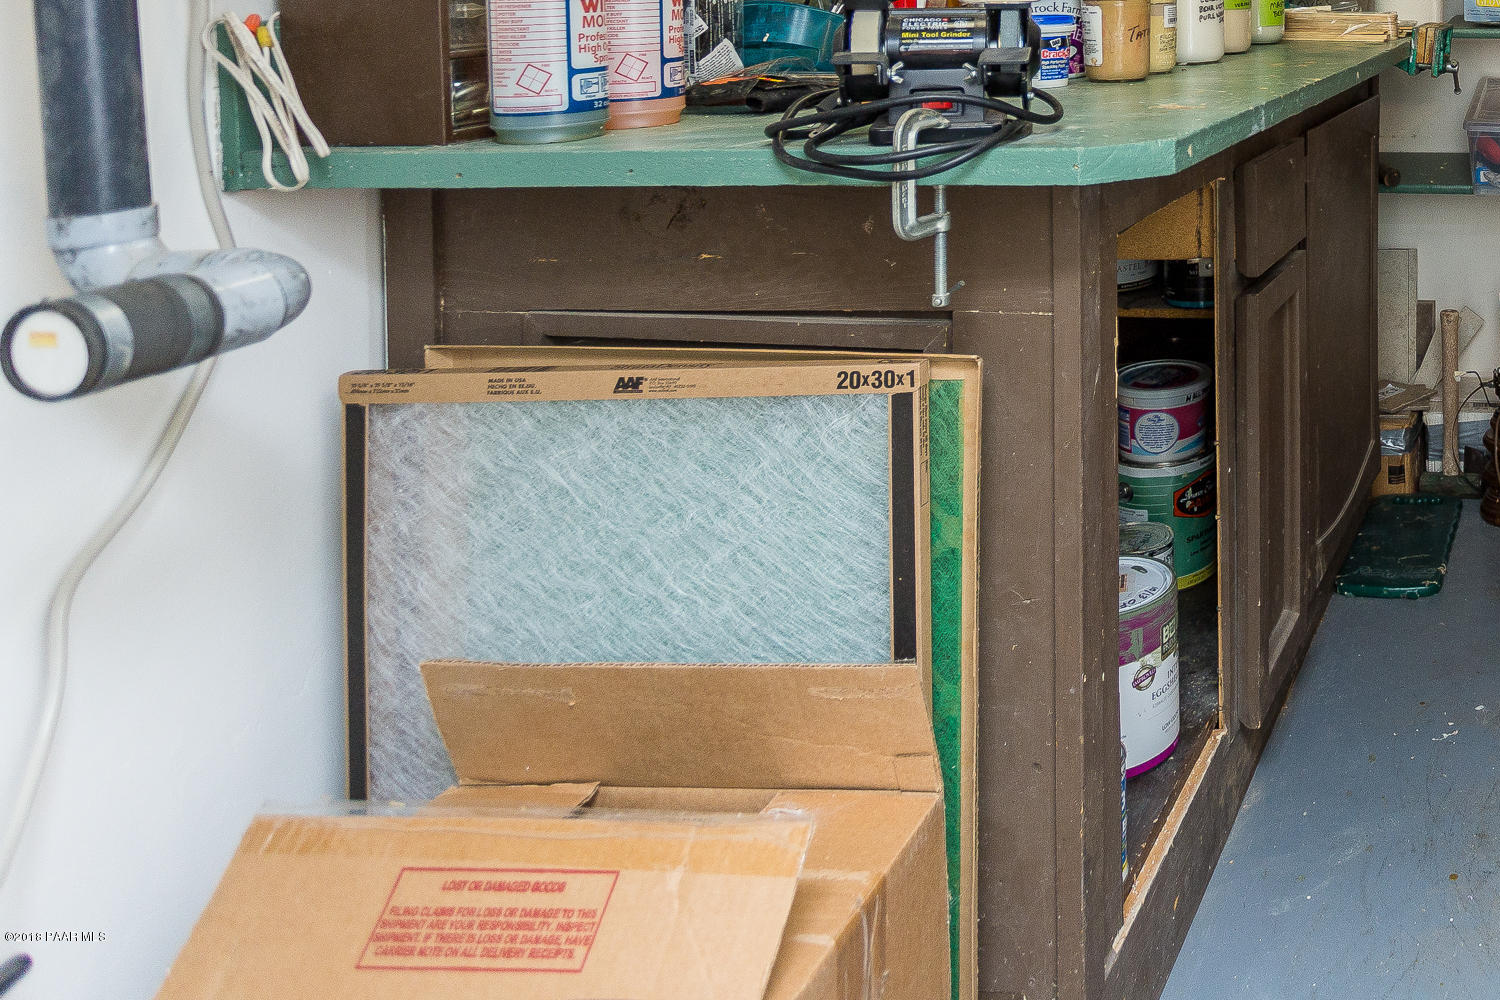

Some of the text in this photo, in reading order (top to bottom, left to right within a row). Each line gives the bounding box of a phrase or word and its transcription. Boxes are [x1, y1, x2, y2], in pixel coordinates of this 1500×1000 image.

[578, 44, 601, 56] High
[614, 376, 644, 393] AAF
[836, 369, 916, 390] 20x30x1
[484, 881, 530, 893] DAMAGED
